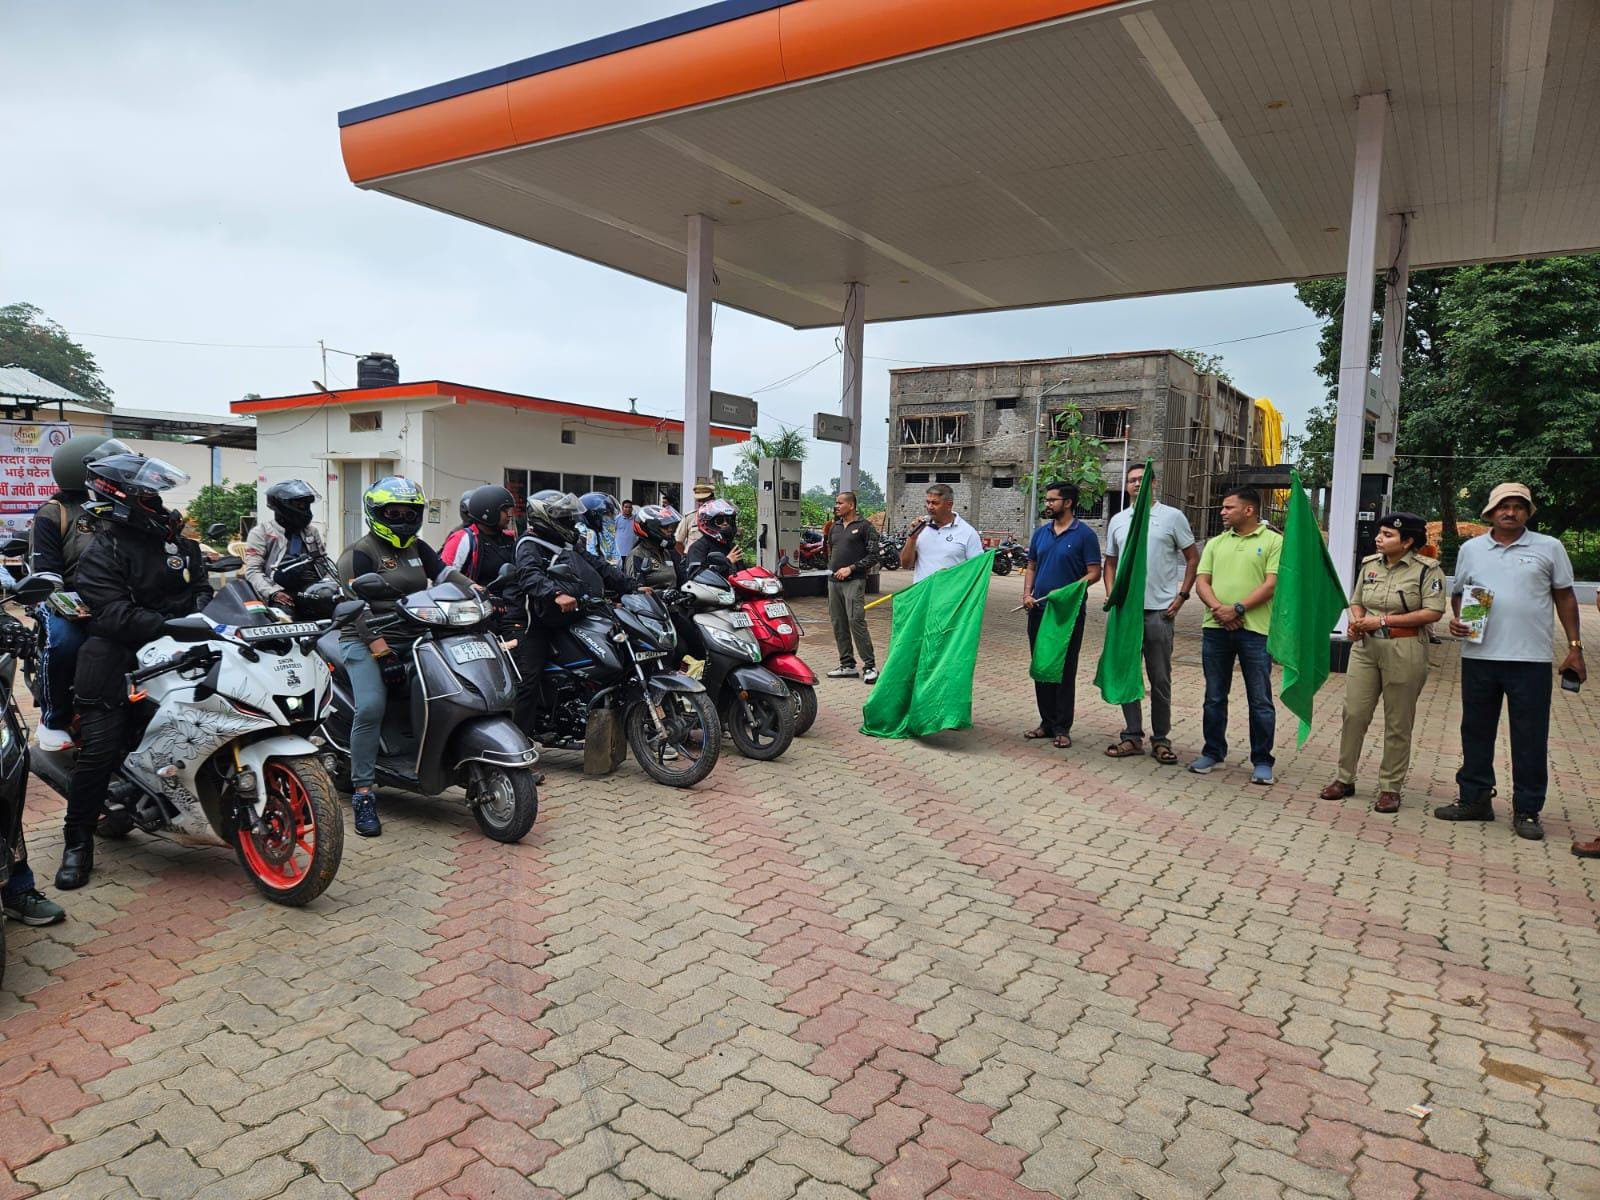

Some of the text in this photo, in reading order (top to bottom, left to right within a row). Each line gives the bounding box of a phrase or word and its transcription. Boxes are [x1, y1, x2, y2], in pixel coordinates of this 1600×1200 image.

[5, 465, 49, 479] भाई पटेल
[11, 482, 35, 496] जयंती
